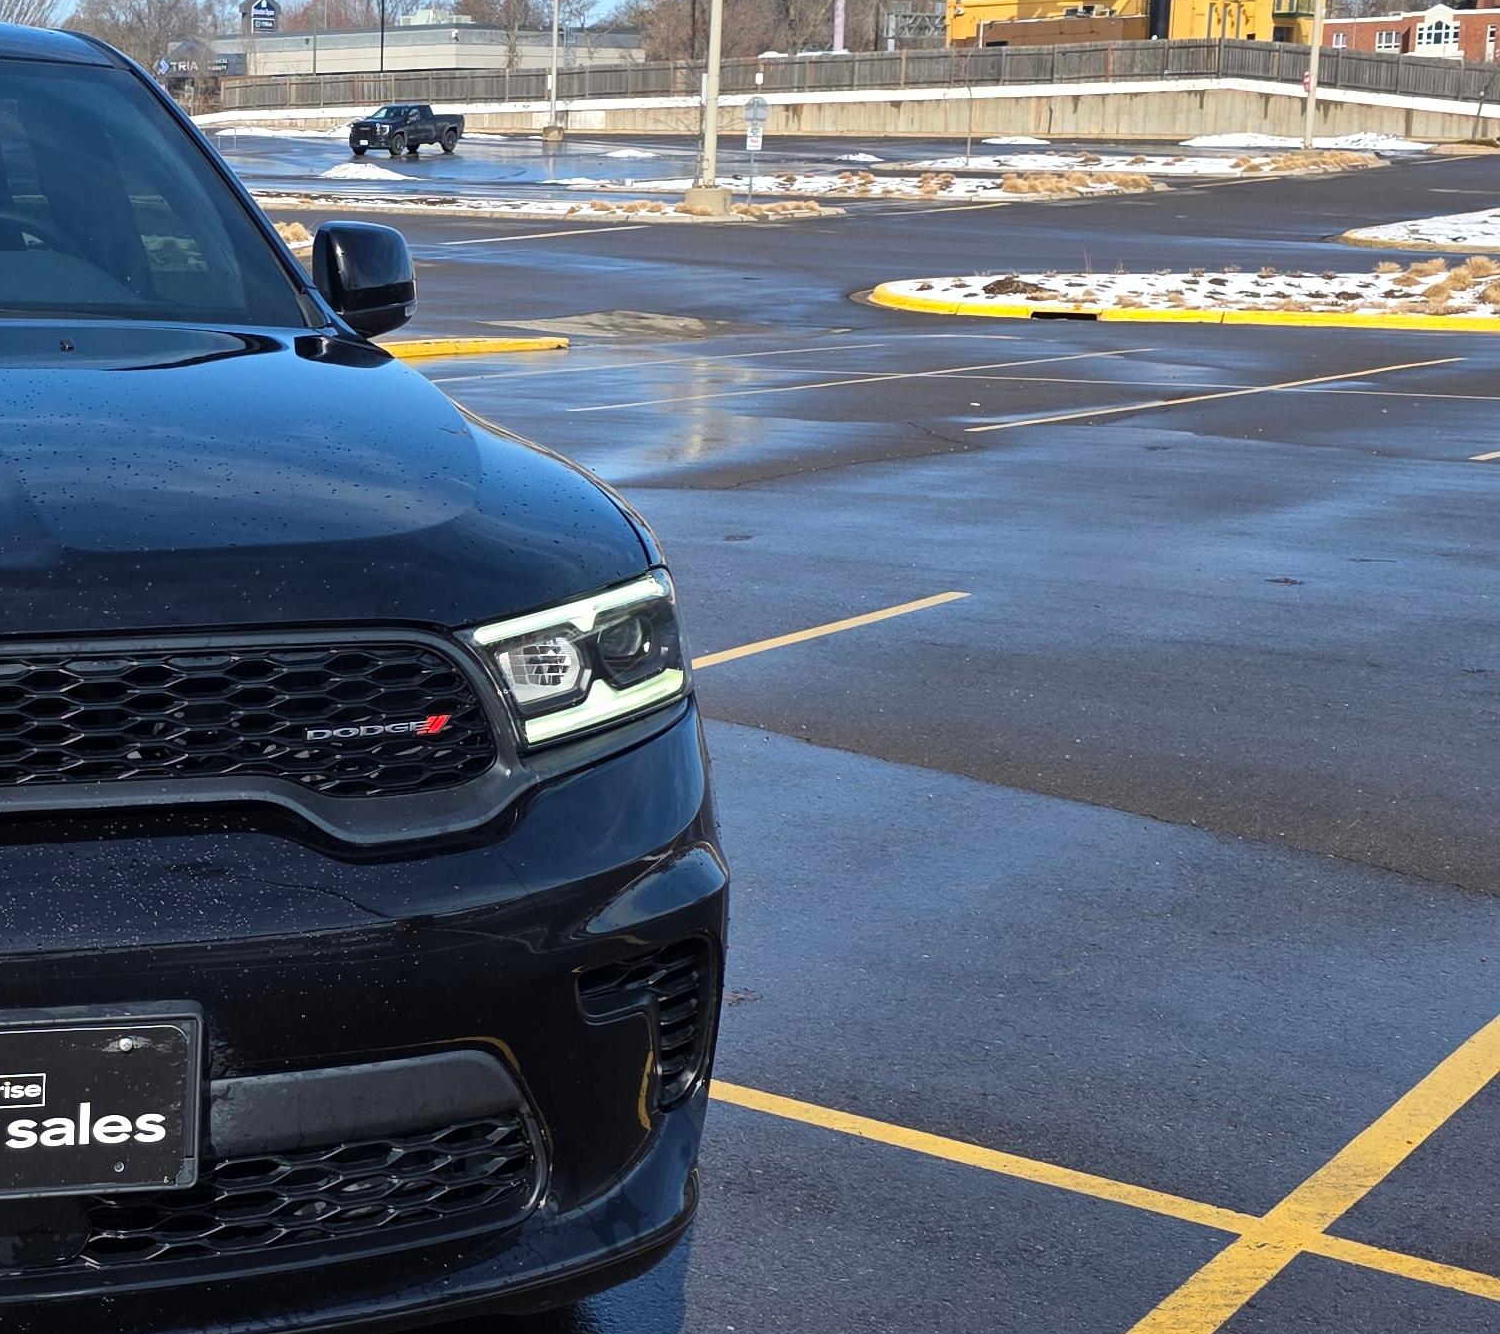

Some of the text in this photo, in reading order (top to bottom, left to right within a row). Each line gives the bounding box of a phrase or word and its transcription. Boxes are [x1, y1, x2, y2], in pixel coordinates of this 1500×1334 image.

[170, 59, 199, 72] TRIA
[306, 720, 431, 741] DODGE
[5, 1102, 167, 1149] sales
